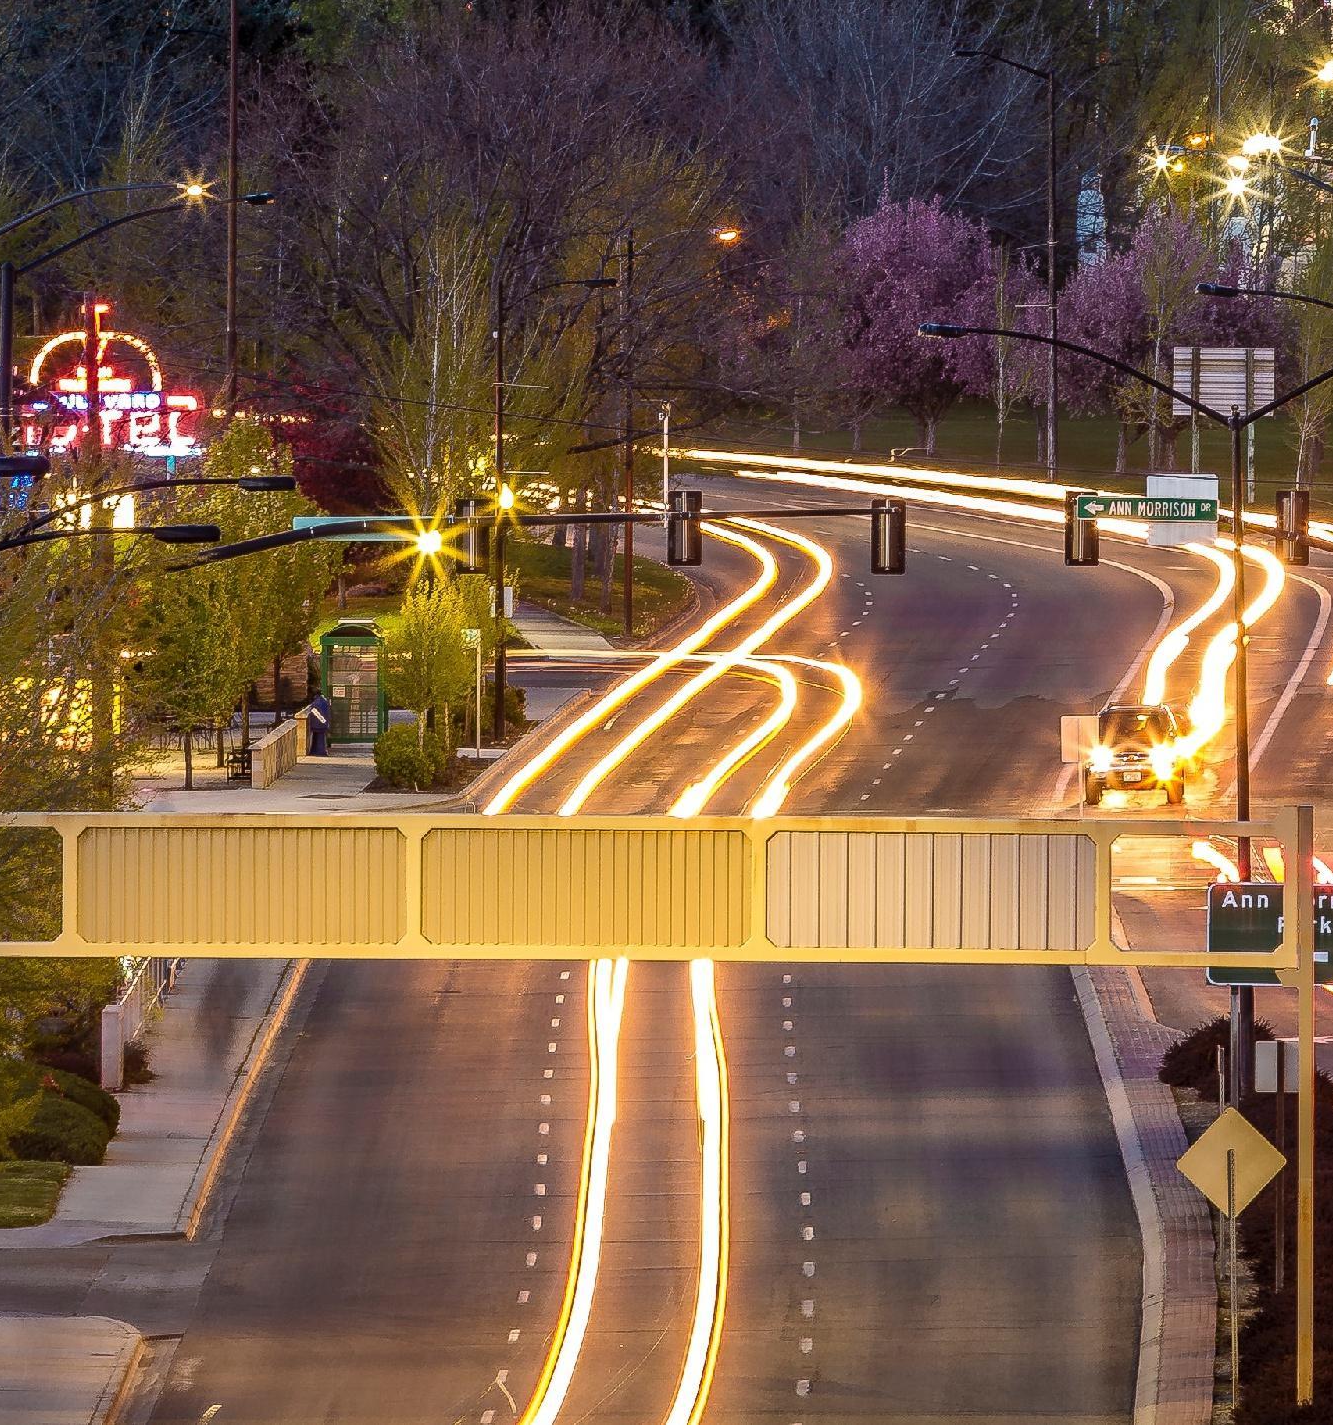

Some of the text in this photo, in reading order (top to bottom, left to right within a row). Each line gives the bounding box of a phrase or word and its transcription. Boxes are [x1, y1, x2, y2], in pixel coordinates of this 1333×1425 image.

[1108, 502, 1212, 518] ANN MORRISON DR
[1221, 891, 1269, 909] Ann
[1277, 916, 1332, 934] Pk
